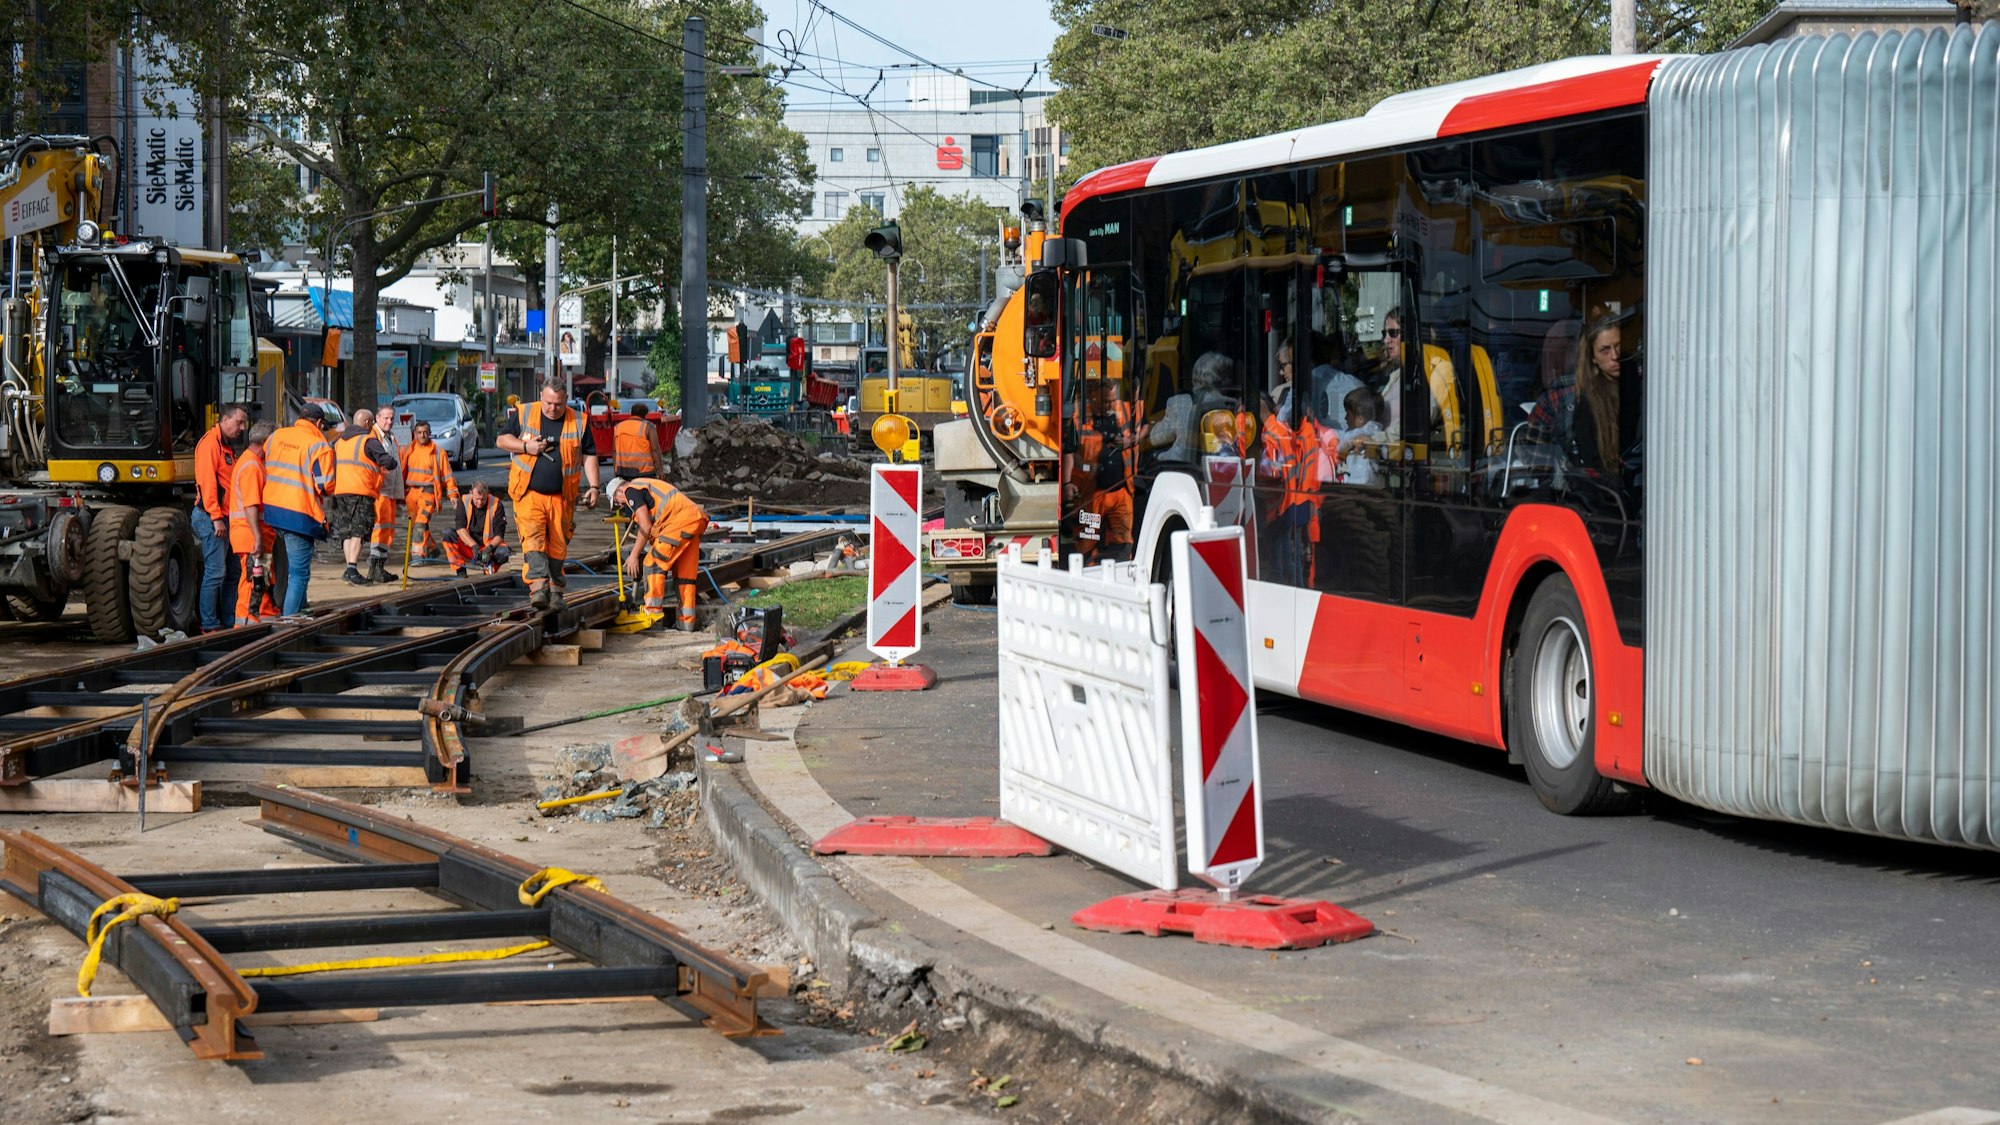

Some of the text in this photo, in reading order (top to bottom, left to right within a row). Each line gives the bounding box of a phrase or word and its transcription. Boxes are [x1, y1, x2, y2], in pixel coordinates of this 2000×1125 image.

[146, 127, 167, 204] SieMatic
[174, 137, 195, 212] SieMatic
[21, 196, 50, 220] EIFFAGE
[1104, 221, 1120, 236] MAN
